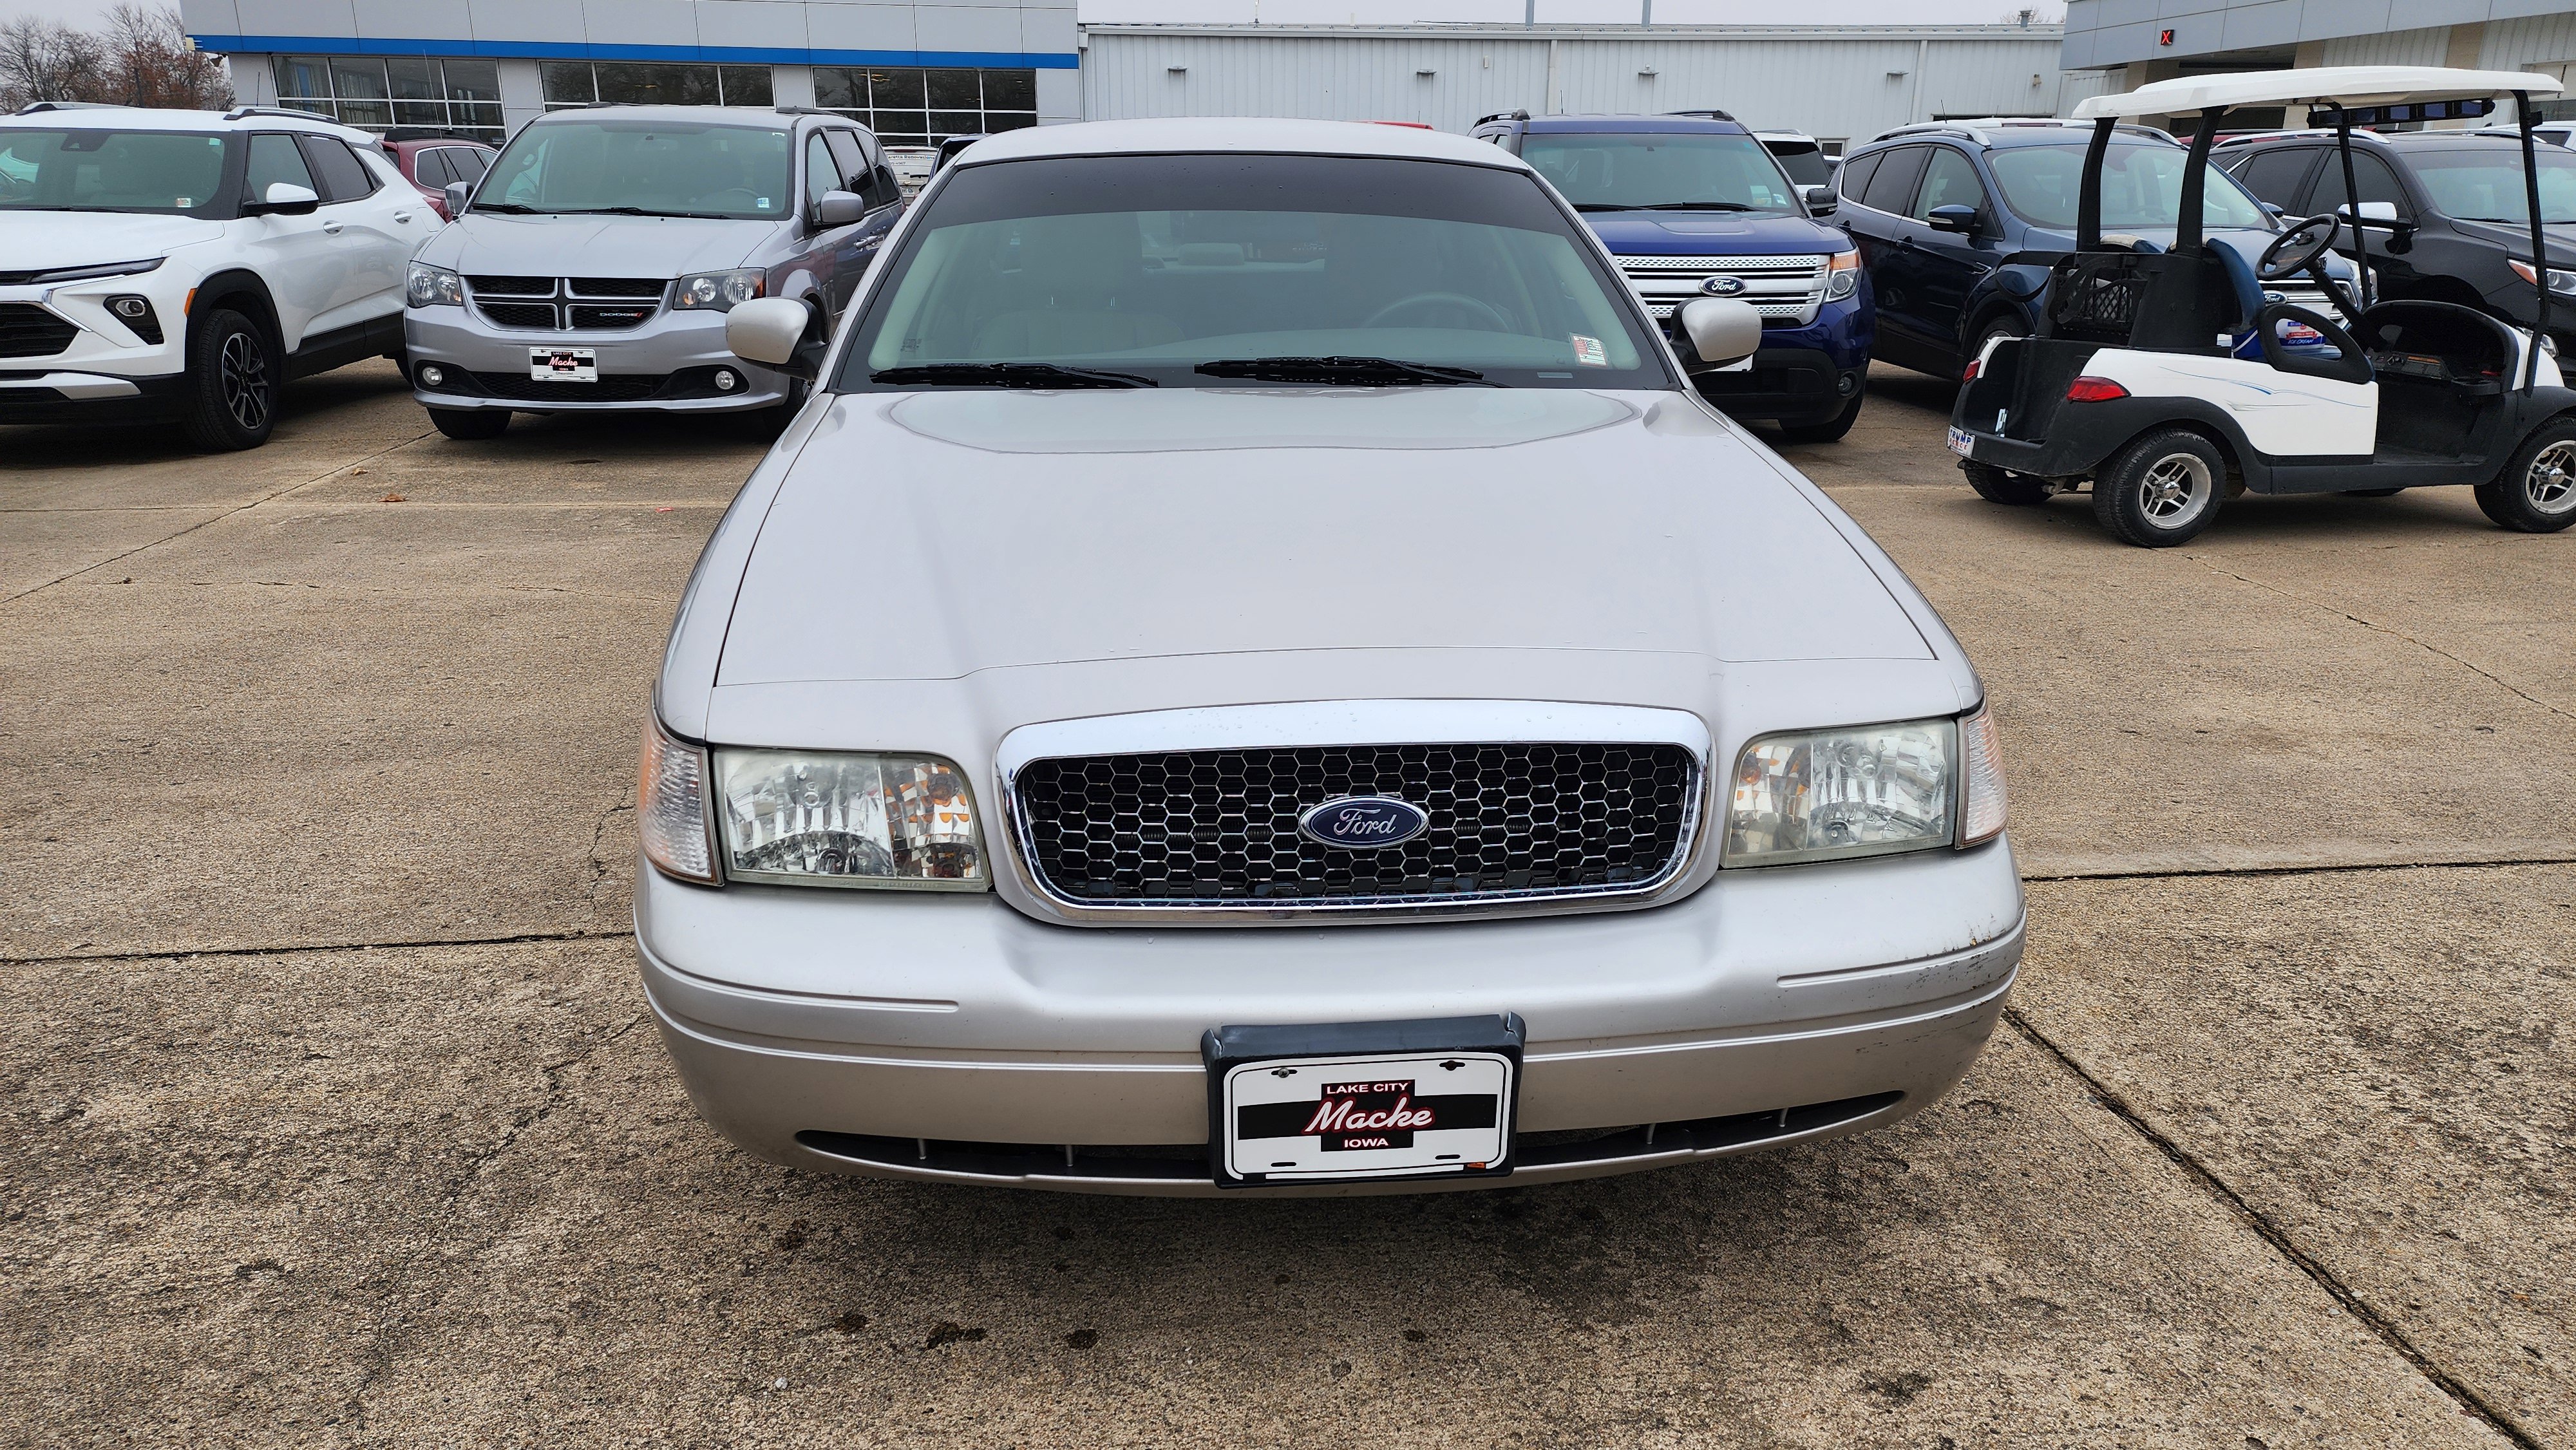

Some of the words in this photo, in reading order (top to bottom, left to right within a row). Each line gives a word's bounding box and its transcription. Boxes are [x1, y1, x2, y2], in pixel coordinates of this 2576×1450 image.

[1711, 279, 1737, 290] Ford
[547, 356, 578, 366] Macke
[1950, 429, 1971, 444] TRUMP
[1333, 808, 1397, 836] Ford
[1327, 1085, 1368, 1095] LAKE
[1373, 1082, 1408, 1092] CITY
[1304, 1097, 1432, 1132] Macke
[1344, 1138, 1388, 1148] IOWA
